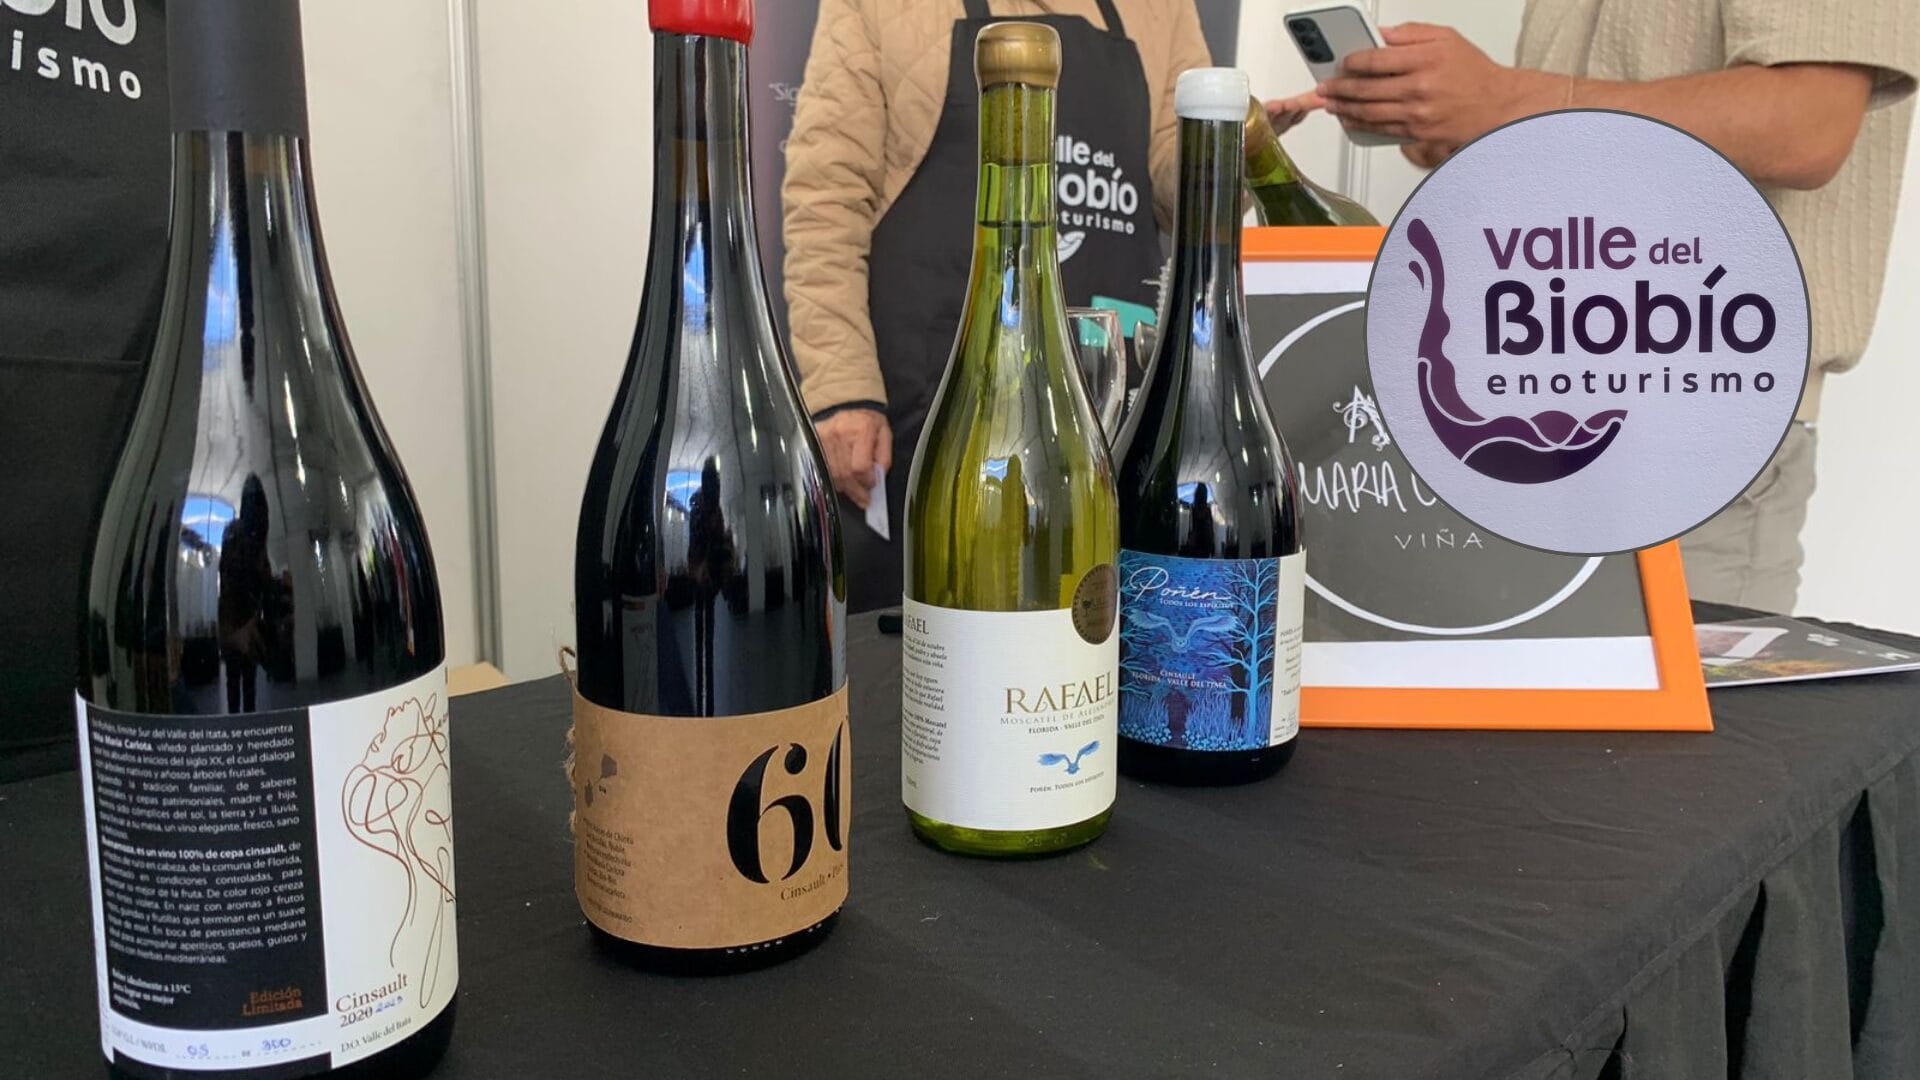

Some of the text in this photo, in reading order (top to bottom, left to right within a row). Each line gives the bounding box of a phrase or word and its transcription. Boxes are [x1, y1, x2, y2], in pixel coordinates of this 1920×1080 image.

[11, 31, 141, 99] ismo
[1056, 135, 1115, 168] lle del
[1057, 167, 1139, 215] obío
[1061, 210, 1135, 235] turismo
[1298, 460, 1407, 513] MARIA
[1394, 528, 1484, 550] VIÑA
[1006, 670, 1114, 715] RAFAEL
[231, 730, 242, 739] se
[243, 724, 294, 737] encuentra
[1028, 726, 1059, 734] FLORIDA
[237, 743, 243, 752] y
[247, 737, 295, 749] heredado
[237, 753, 258, 765] cual
[259, 751, 295, 762] dialoga
[235, 781, 250, 791] de
[260, 777, 297, 789] saberes
[230, 794, 262, 804] madre
[266, 793, 273, 802] e
[249, 809, 255, 818] y
[276, 816, 300, 827] sano
[178, 849, 204, 859] 100%
[205, 849, 219, 859] de
[220, 849, 244, 860] cepa
[288, 841, 302, 852] de
[212, 862, 251, 872] comuna
[253, 858, 266, 869] de
[281, 868, 303, 880] para
[206, 888, 221, 899] De
[223, 887, 247, 898] color
[251, 886, 270, 896] rojo
[272, 880, 304, 893] cereza
[780, 873, 826, 901] Cinsault
[203, 903, 222, 912] con
[226, 900, 262, 911] aromas
[265, 899, 273, 908] a
[276, 894, 305, 905] frutos
[247, 913, 260, 922] en
[262, 911, 276, 920] un
[278, 906, 306, 918] suave
[264, 920, 306, 932] mediana
[300, 932, 307, 941] y
[250, 986, 301, 1004] Edición
[335, 972, 409, 1014] Cinsault
[242, 999, 303, 1016] Limitada
[340, 1006, 373, 1028] 2020
[361, 1029, 383, 1046] Valle
[383, 1023, 395, 1036] del
